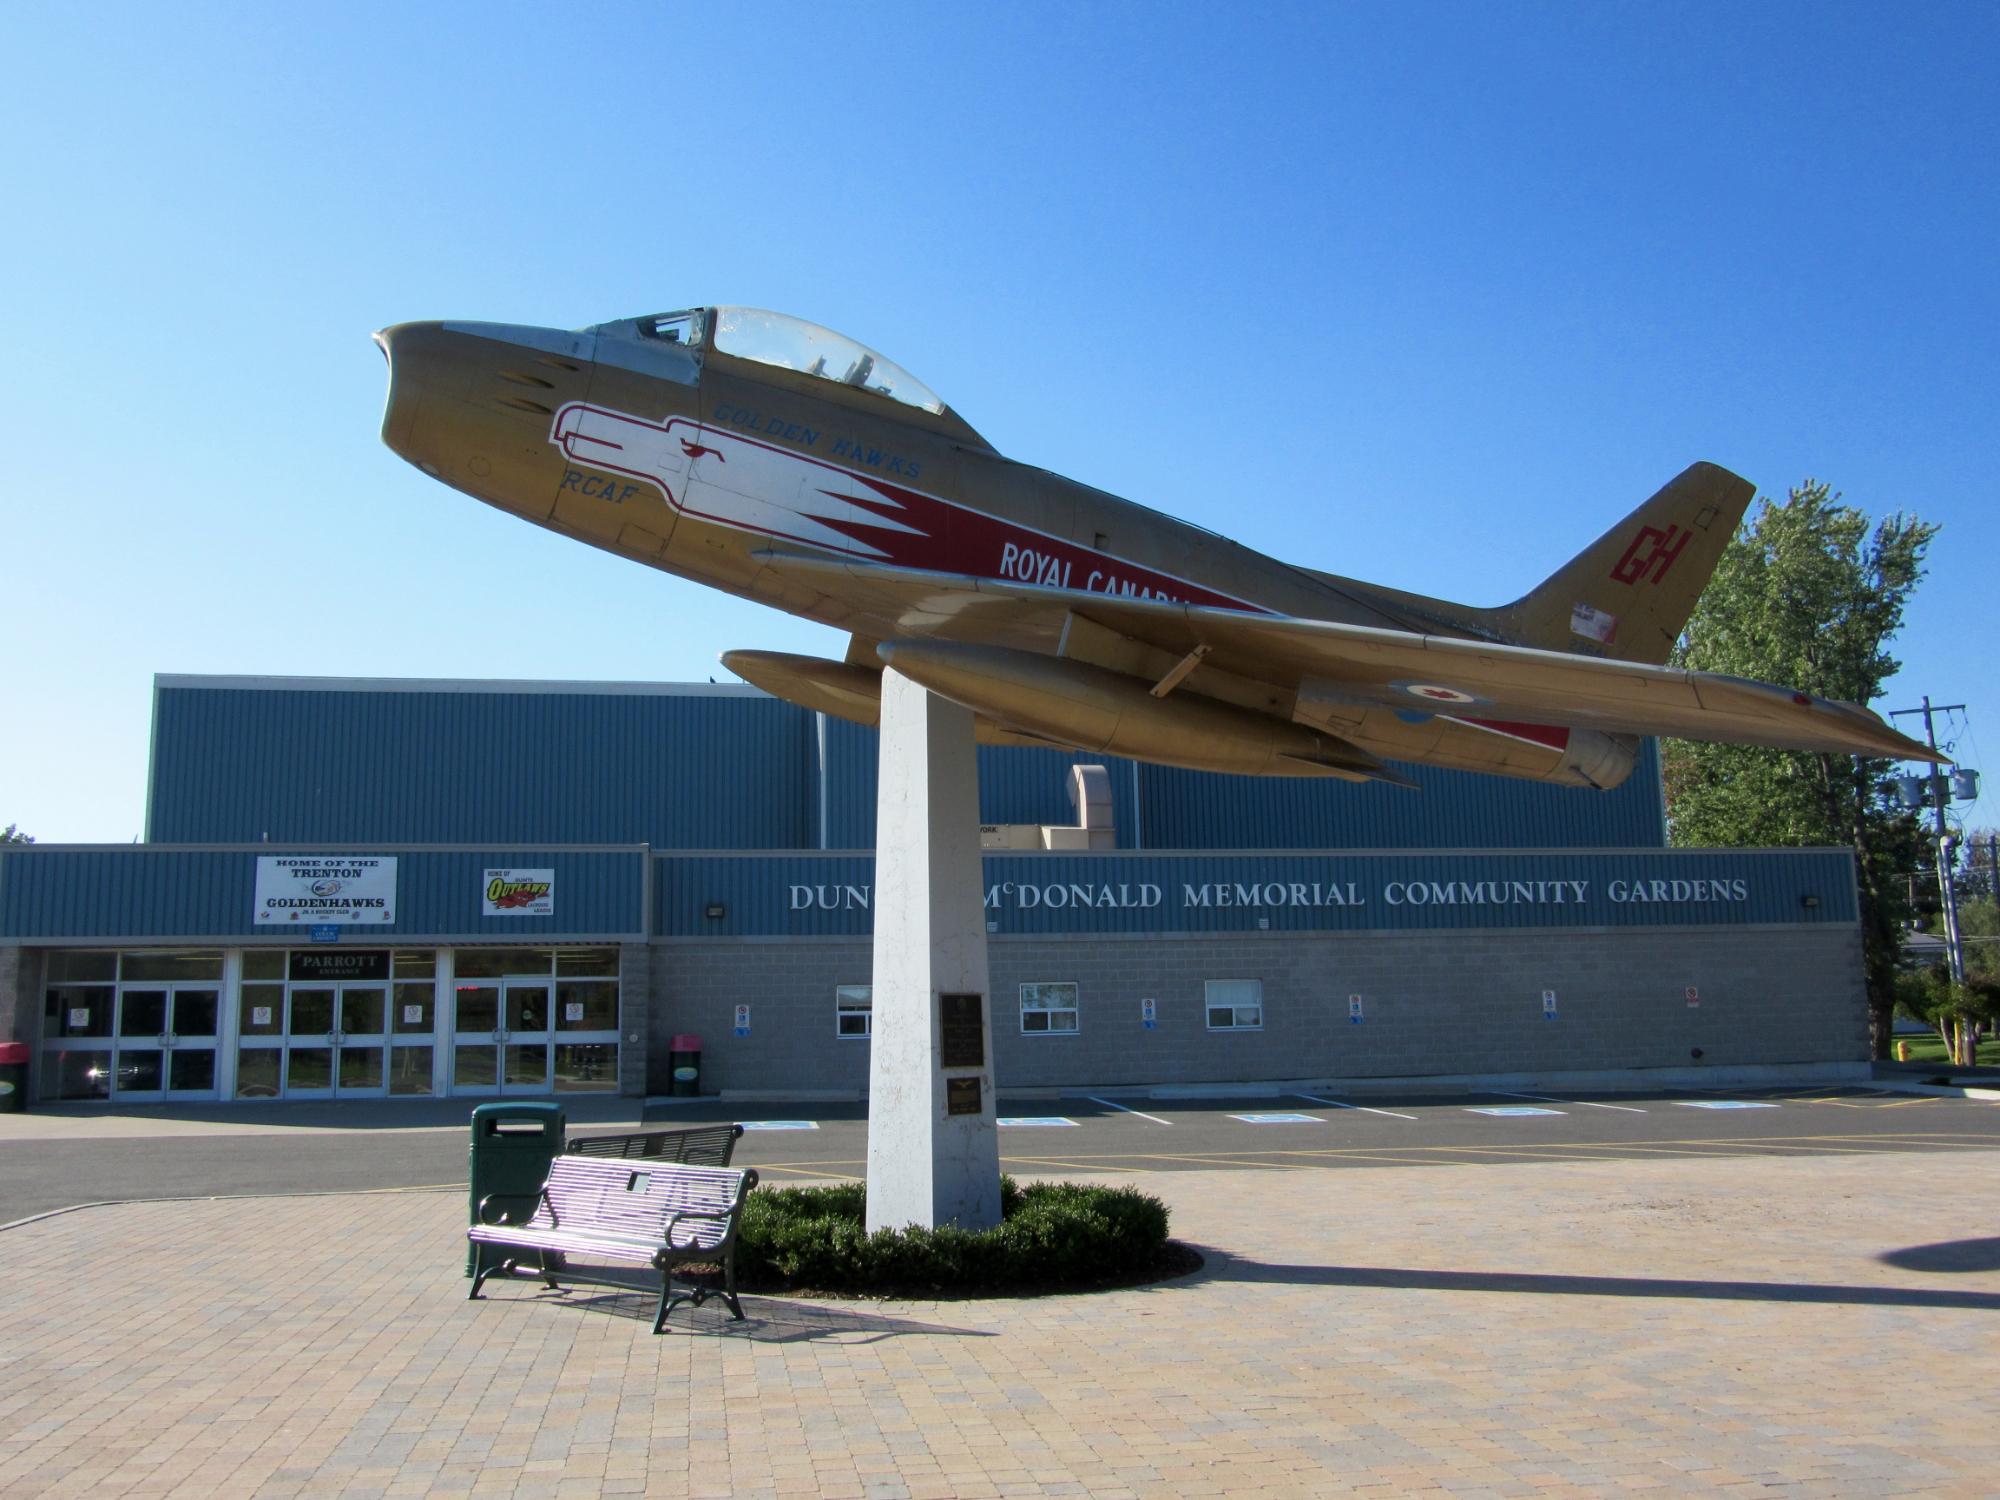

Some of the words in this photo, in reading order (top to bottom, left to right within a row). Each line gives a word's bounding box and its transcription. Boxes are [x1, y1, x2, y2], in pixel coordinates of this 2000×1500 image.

[832, 438, 920, 478] HAWKS
[560, 470, 639, 504] RCAF
[291, 869, 363, 878] TRENTON
[266, 898, 385, 908] GOLDENHAWKS
[789, 884, 871, 910] DUN
[1183, 882, 1365, 907] MEMORIAL
[1384, 880, 1589, 906] COMMUNITY
[1607, 879, 1747, 902] GARDENS
[303, 955, 378, 967] PARROTT
